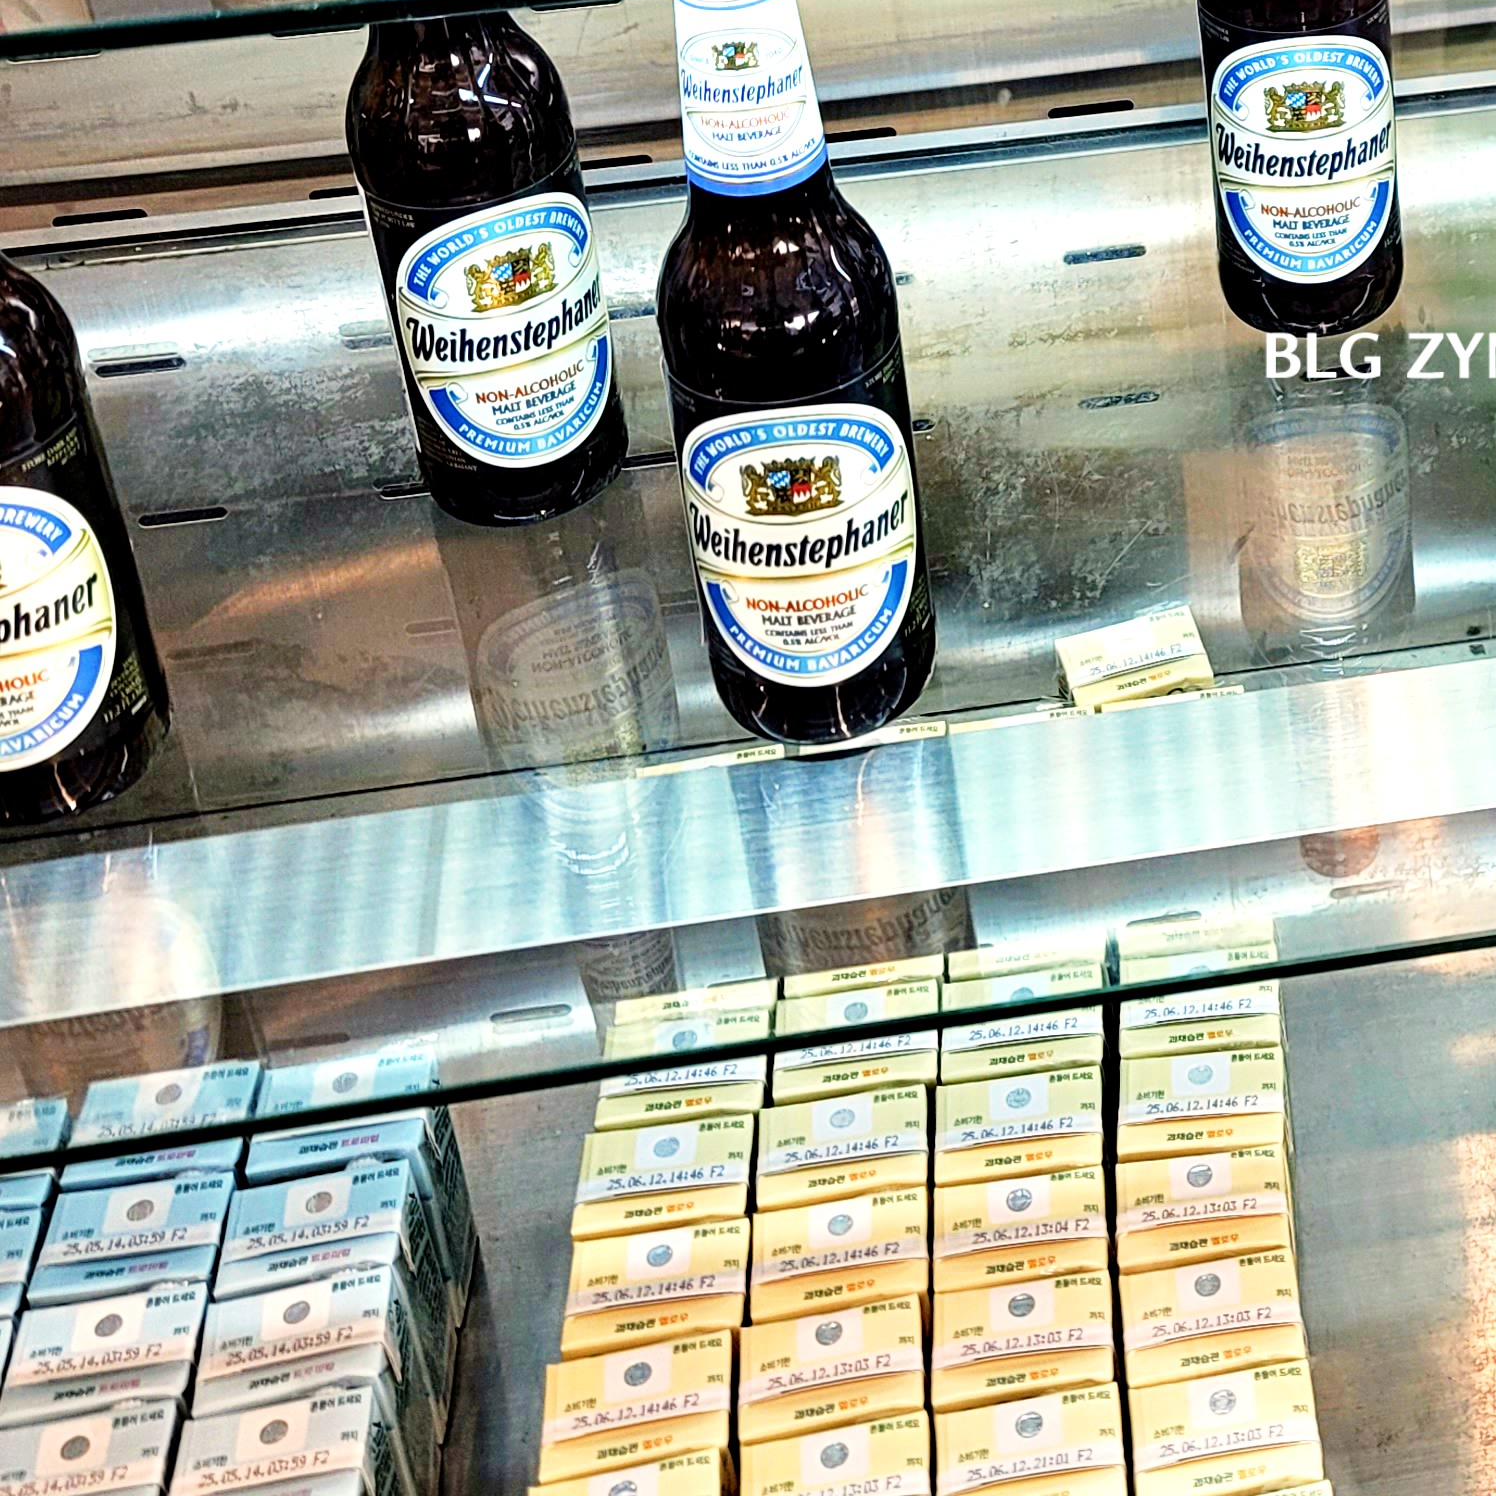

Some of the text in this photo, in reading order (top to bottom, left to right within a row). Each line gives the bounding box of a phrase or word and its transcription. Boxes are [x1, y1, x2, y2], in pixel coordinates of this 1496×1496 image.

[681, 64, 803, 104] Weihenstephaner
[1223, 74, 1238, 97] THE
[1293, 51, 1344, 64] OLDEST
[1346, 53, 1381, 87] BREWERY
[701, 107, 791, 130] NON-ALCOHOLIC
[1215, 120, 1392, 180] Weihenstephaner
[1260, 196, 1361, 218] NON-ALCOHOLIC
[414, 262, 431, 288] THE
[494, 211, 547, 233] OLDEST
[549, 210, 585, 240] BREWERY
[1243, 219, 1378, 271] PREMIUM BAVARICUM
[406, 273, 601, 363] Weihenstephaner
[476, 360, 585, 404] NON-ALCOHOLIC
[492, 380, 576, 416] MALT BEVERAGE
[459, 381, 602, 454] PREMIUM BAVARICUM
[694, 451, 709, 476] THE
[773, 422, 837, 438] OLDEST
[839, 424, 890, 459] BREWERY
[689, 489, 908, 568] Weihenstephaner
[746, 584, 869, 613] NON-ALCOHOLIC
[761, 604, 857, 626] MALT BEVERAGE
[729, 608, 894, 671] PREMIUM BAVARICUM
[1064, 1017, 1078, 1030] F2
[710, 1165, 725, 1178] F2
[354, 1214, 370, 1229] F2
[1243, 1198, 1257, 1211] F2
[146, 1343, 162, 1359] F2
